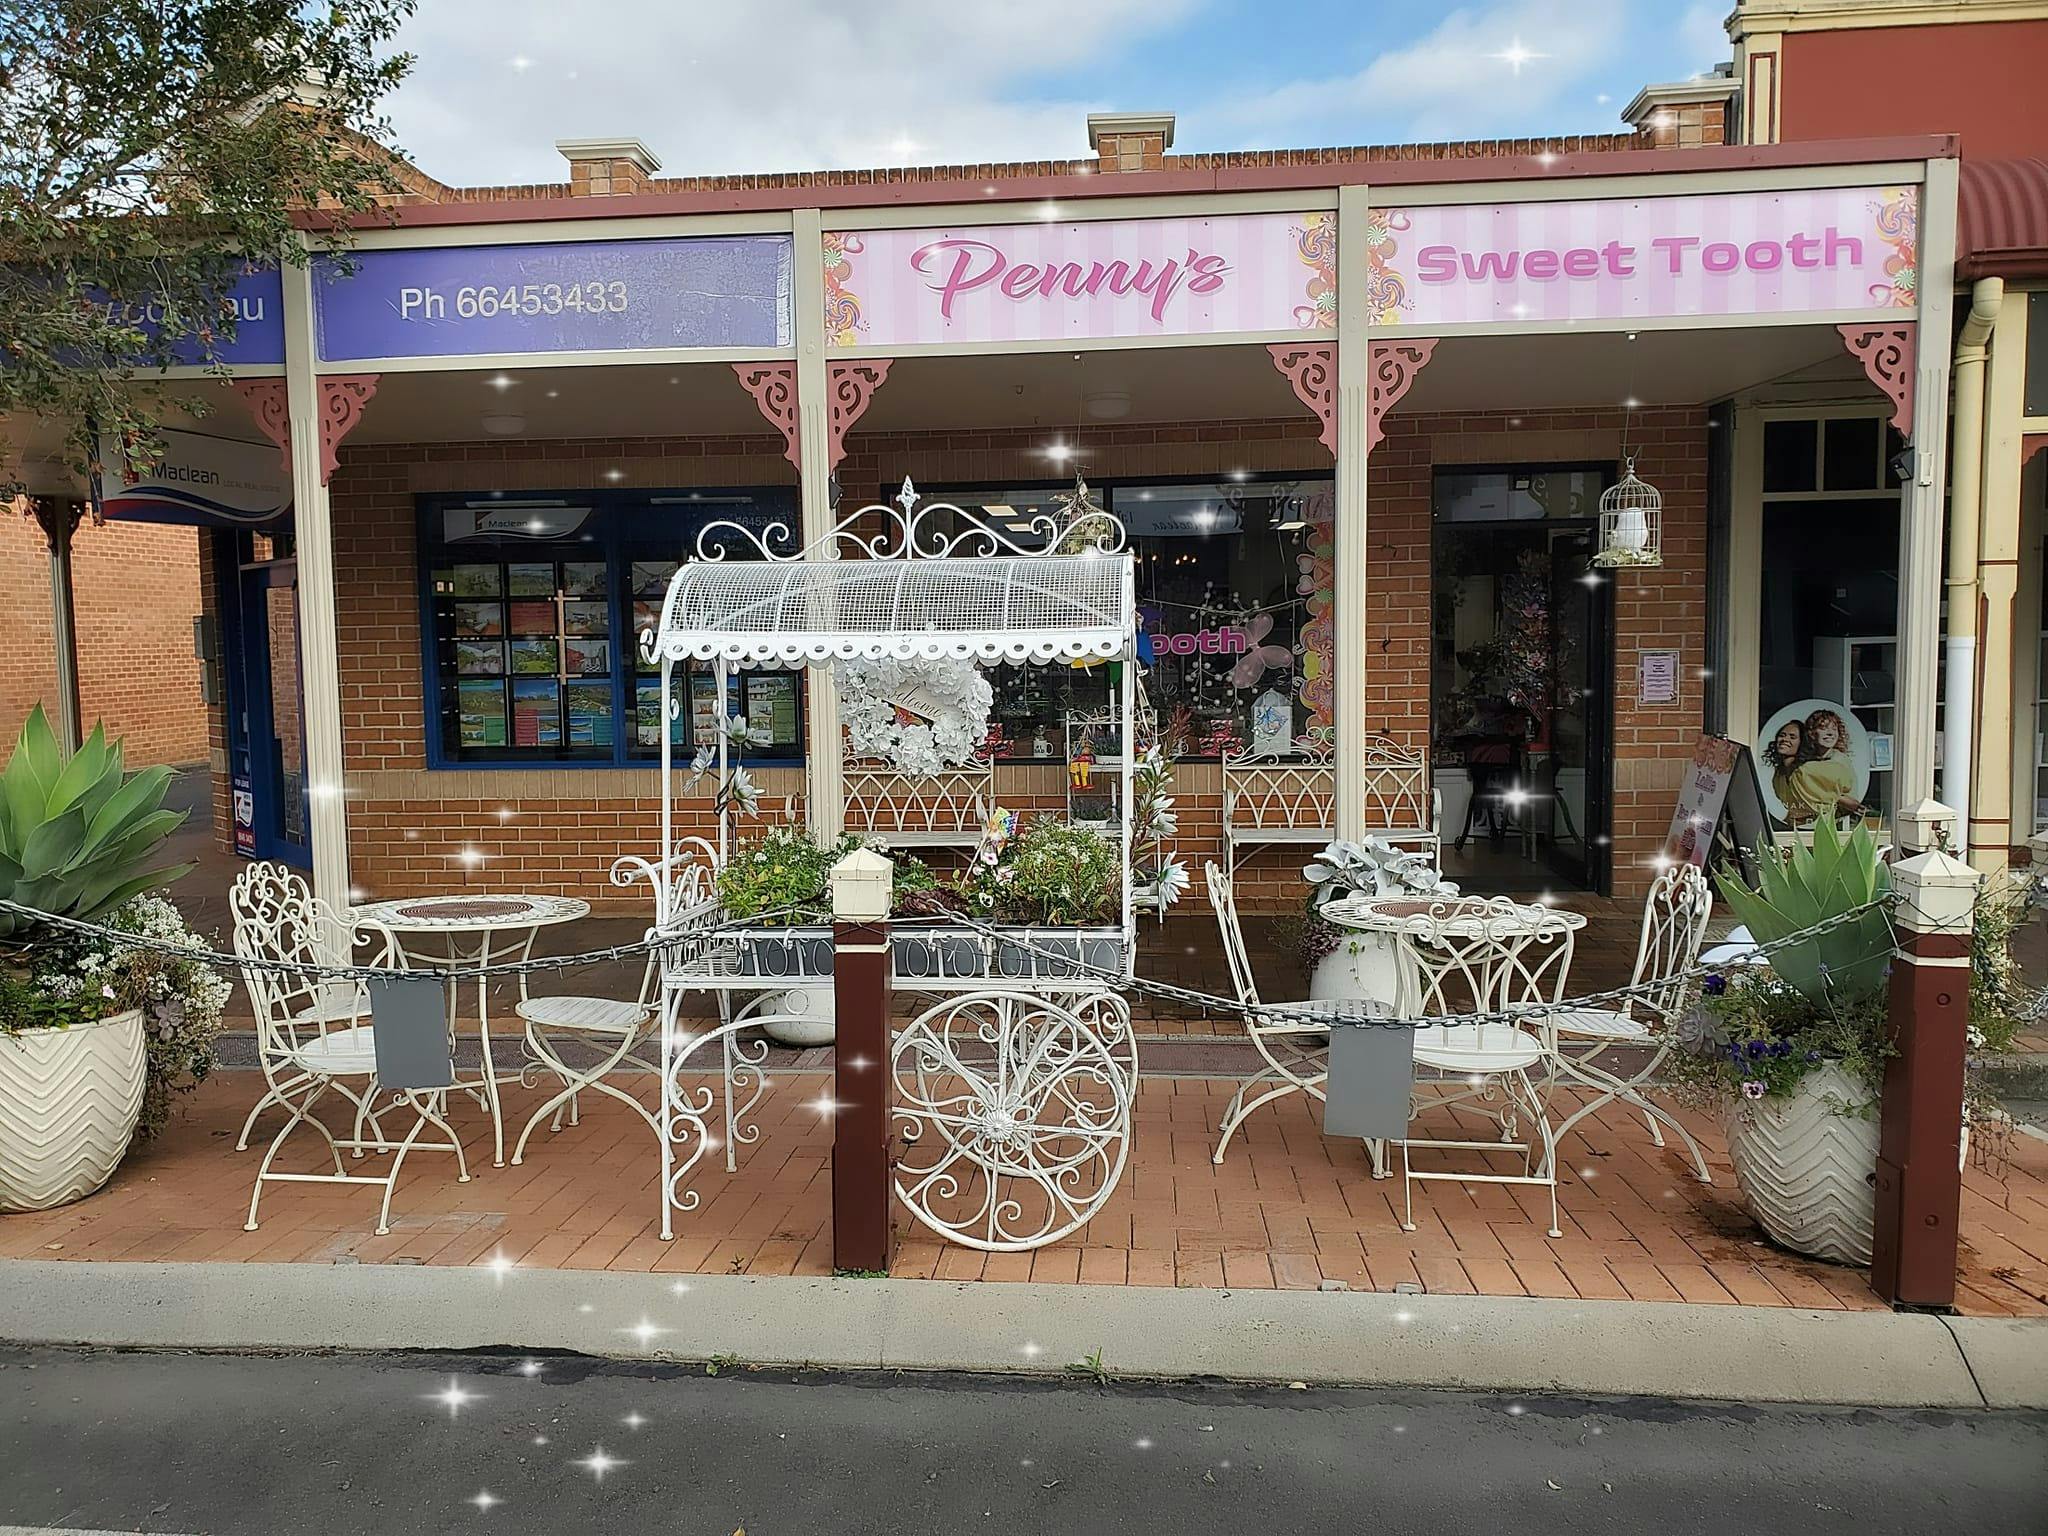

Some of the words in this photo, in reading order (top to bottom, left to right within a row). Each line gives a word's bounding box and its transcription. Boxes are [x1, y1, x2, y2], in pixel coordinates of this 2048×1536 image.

[1417, 240, 1636, 281] Sweet
[1652, 226, 1863, 273] Tooth
[910, 239, 1235, 322] Penny's
[401, 287, 445, 320] Ph
[456, 281, 628, 318] 66453433
[152, 462, 220, 485] Maclean
[488, 519, 528, 528] Maclean
[1150, 626, 1246, 656] ooth
